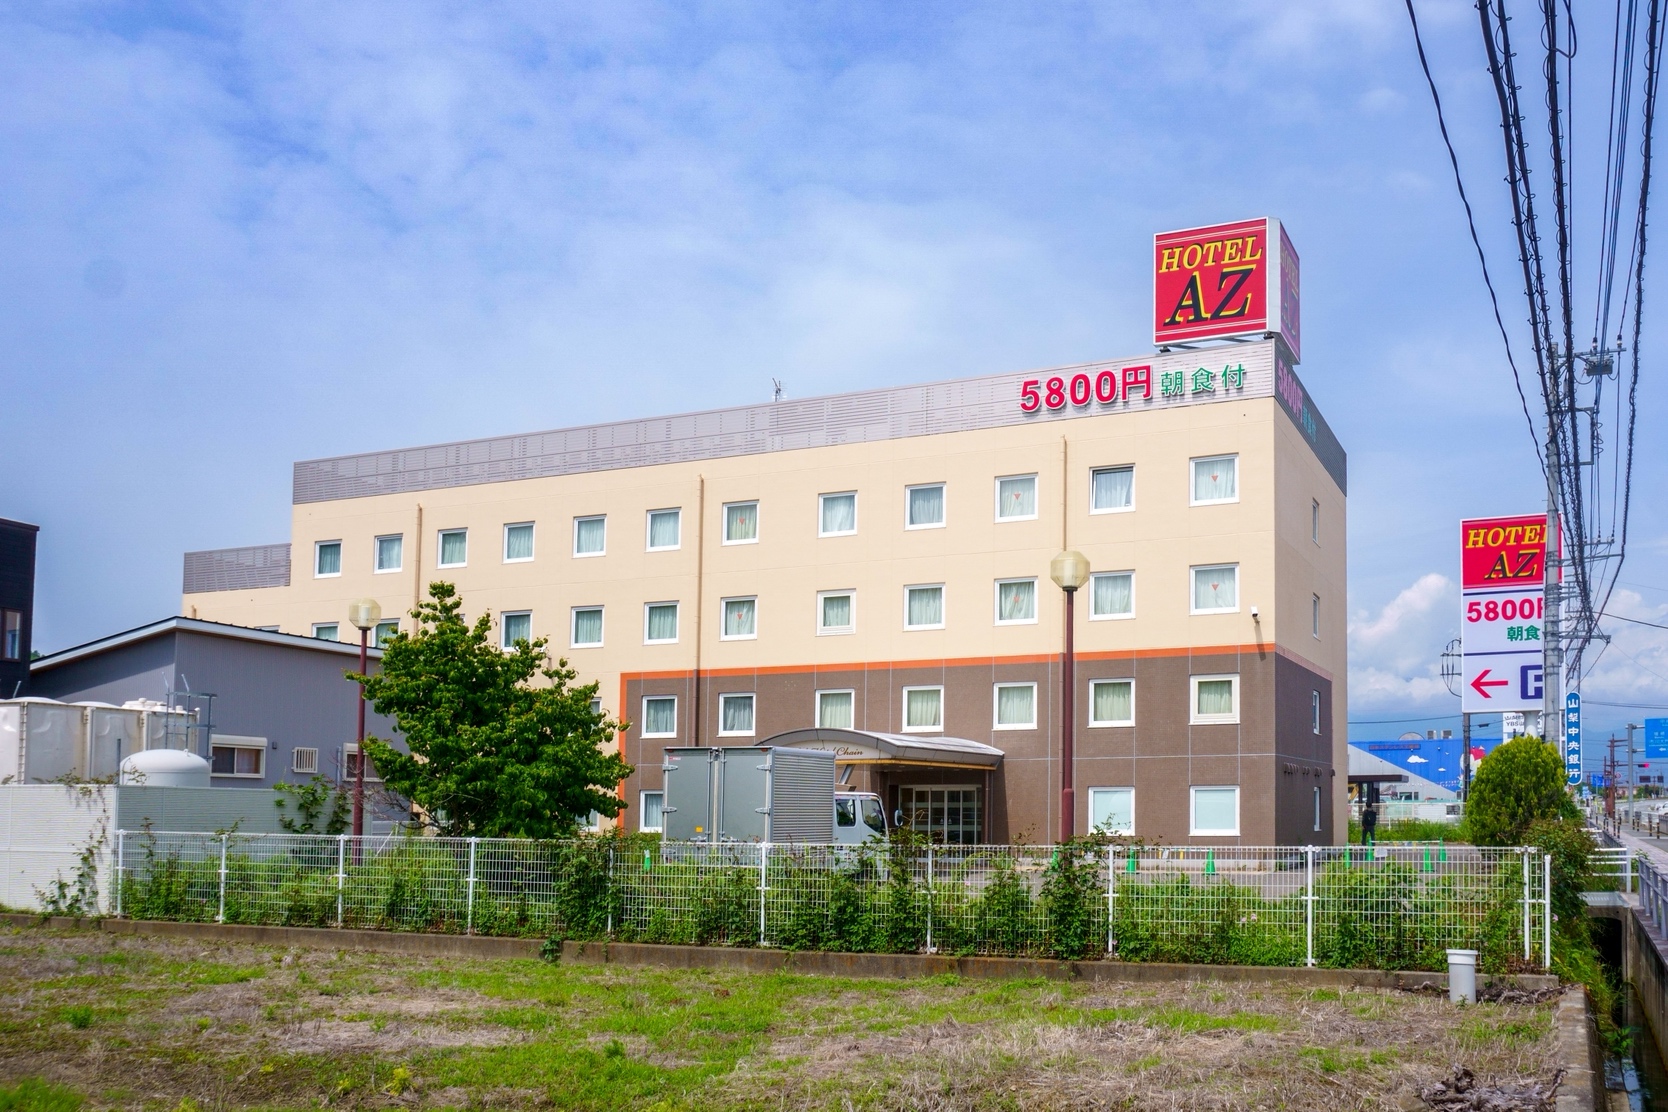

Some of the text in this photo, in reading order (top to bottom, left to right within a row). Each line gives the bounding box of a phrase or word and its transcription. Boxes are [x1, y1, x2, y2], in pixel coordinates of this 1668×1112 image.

[1159, 235, 1263, 273] HOTEL
[1163, 264, 1257, 326] AZ
[1020, 363, 1246, 413] 5800円 朝食付
[1484, 549, 1540, 579] AZ
[836, 746, 863, 756] Chain
[1568, 699, 1580, 778] 山梨中央銀行
